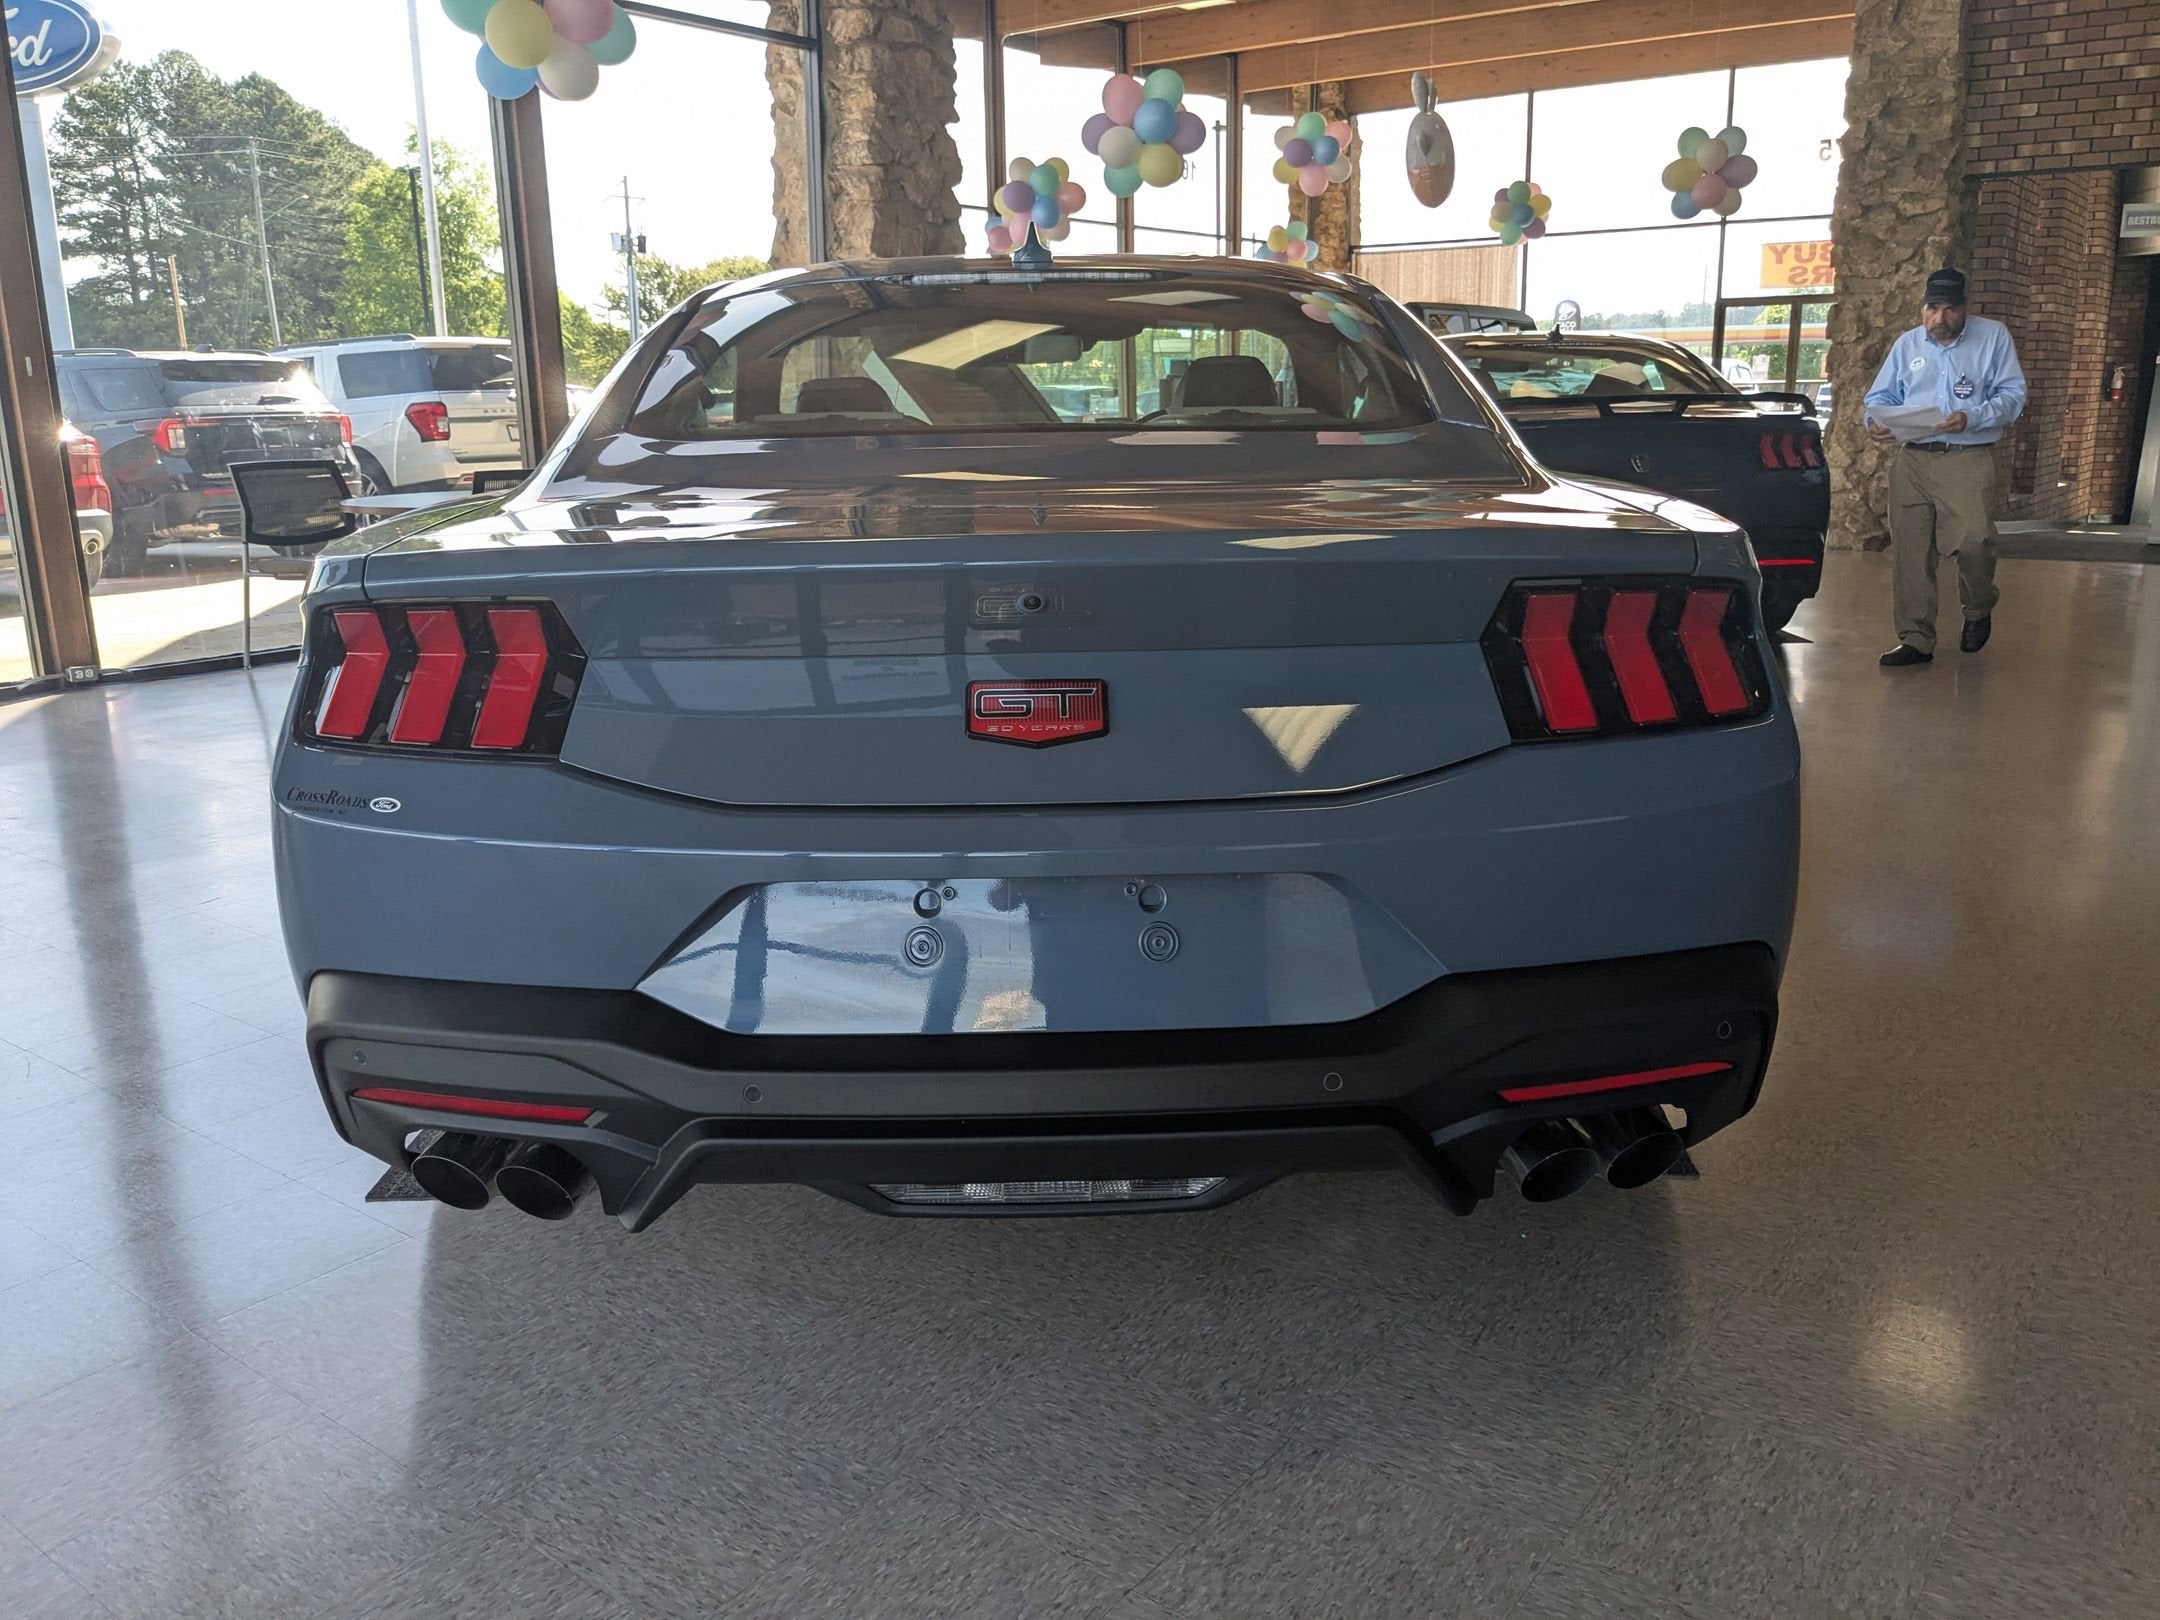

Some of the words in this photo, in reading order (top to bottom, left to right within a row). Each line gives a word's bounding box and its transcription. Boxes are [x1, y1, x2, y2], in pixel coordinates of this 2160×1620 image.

[5, 8, 53, 66] rd
[974, 688, 1097, 720] GT
[1018, 724, 1086, 732] YEARS
